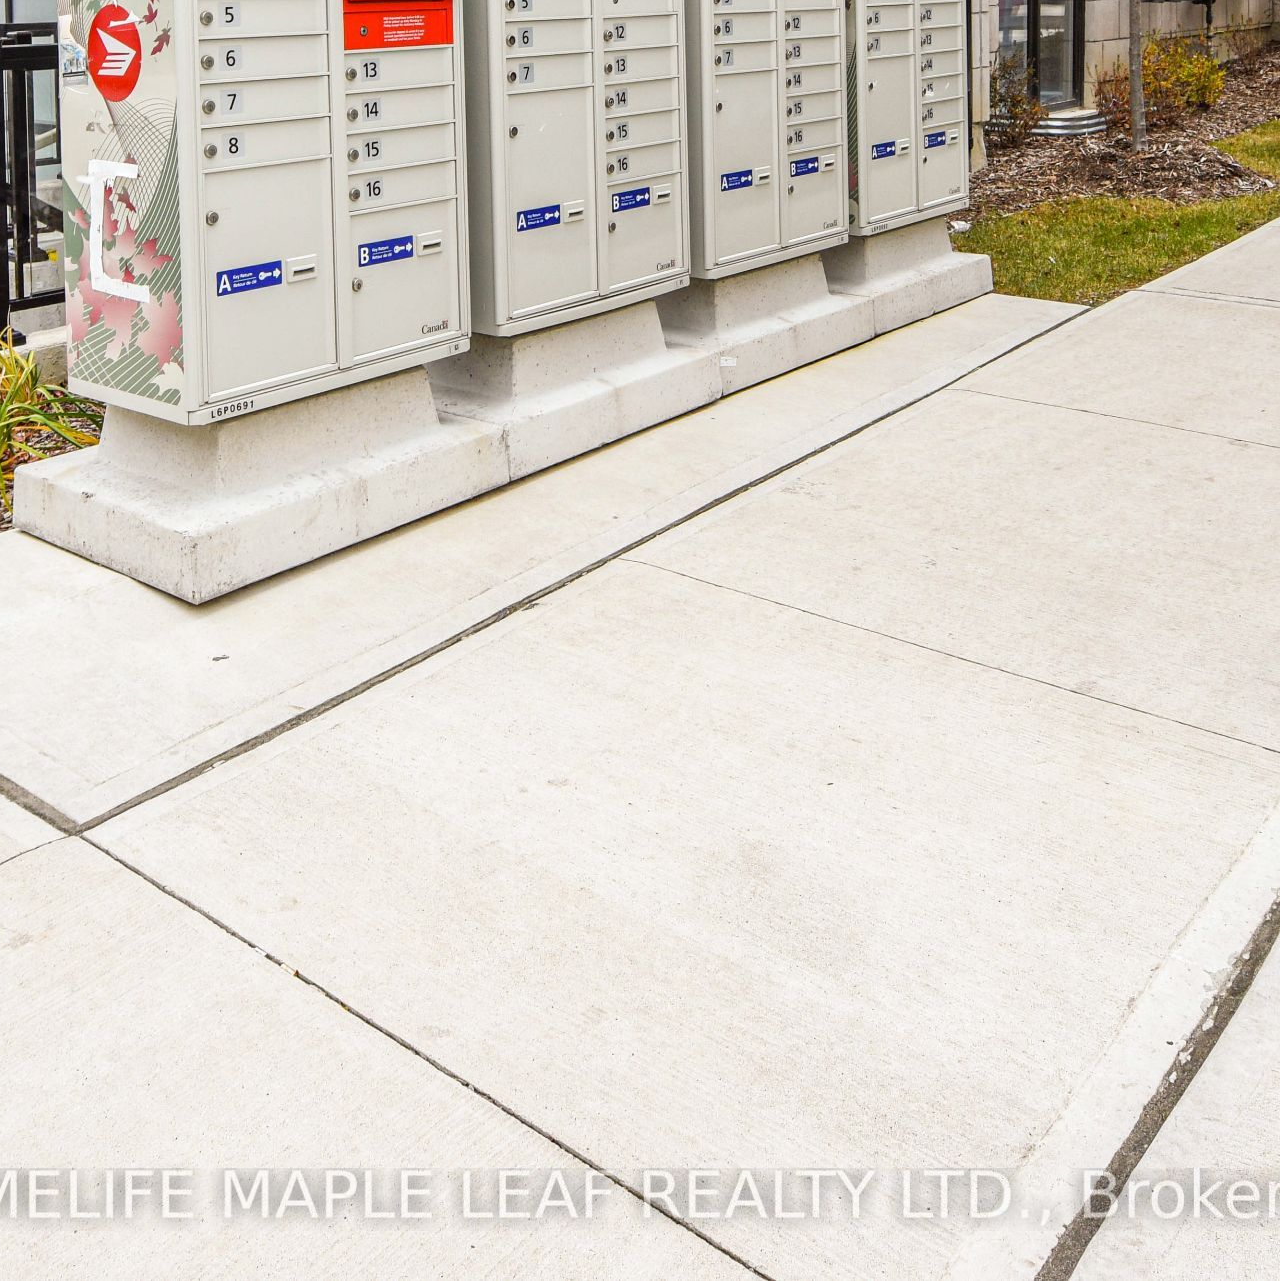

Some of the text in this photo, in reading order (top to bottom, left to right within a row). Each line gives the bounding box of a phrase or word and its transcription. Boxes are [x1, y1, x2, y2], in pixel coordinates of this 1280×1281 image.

[226, 7, 234, 23] 5
[725, 22, 730, 33] 6
[793, 18, 799, 28] 12
[523, 31, 529, 44] 6
[616, 26, 624, 38] 12
[226, 50, 235, 66] 6
[726, 52, 730, 63] 7
[793, 46, 800, 57] 13
[364, 62, 376, 77] 13
[616, 59, 625, 71] 13
[524, 67, 529, 80] 7
[794, 75, 800, 85] 14
[228, 94, 236, 110] 7
[616, 92, 626, 104] 14
[365, 102, 378, 117] 14
[794, 103, 801, 113] 15
[618, 125, 627, 138] 15
[795, 131, 802, 142] 16
[229, 138, 238, 153] 8
[365, 142, 379, 157] 15
[872, 147, 877, 158] A
[618, 158, 627, 171] 16
[791, 163, 796, 175] B
[367, 181, 380, 196] 16
[722, 177, 728, 189] A
[613, 196, 619, 210] B
[518, 214, 526, 229] A
[360, 247, 369, 265] B
[218, 275, 232, 293] A
[421, 320, 448, 334] Canada
[211, 399, 255, 419] L6P0691
